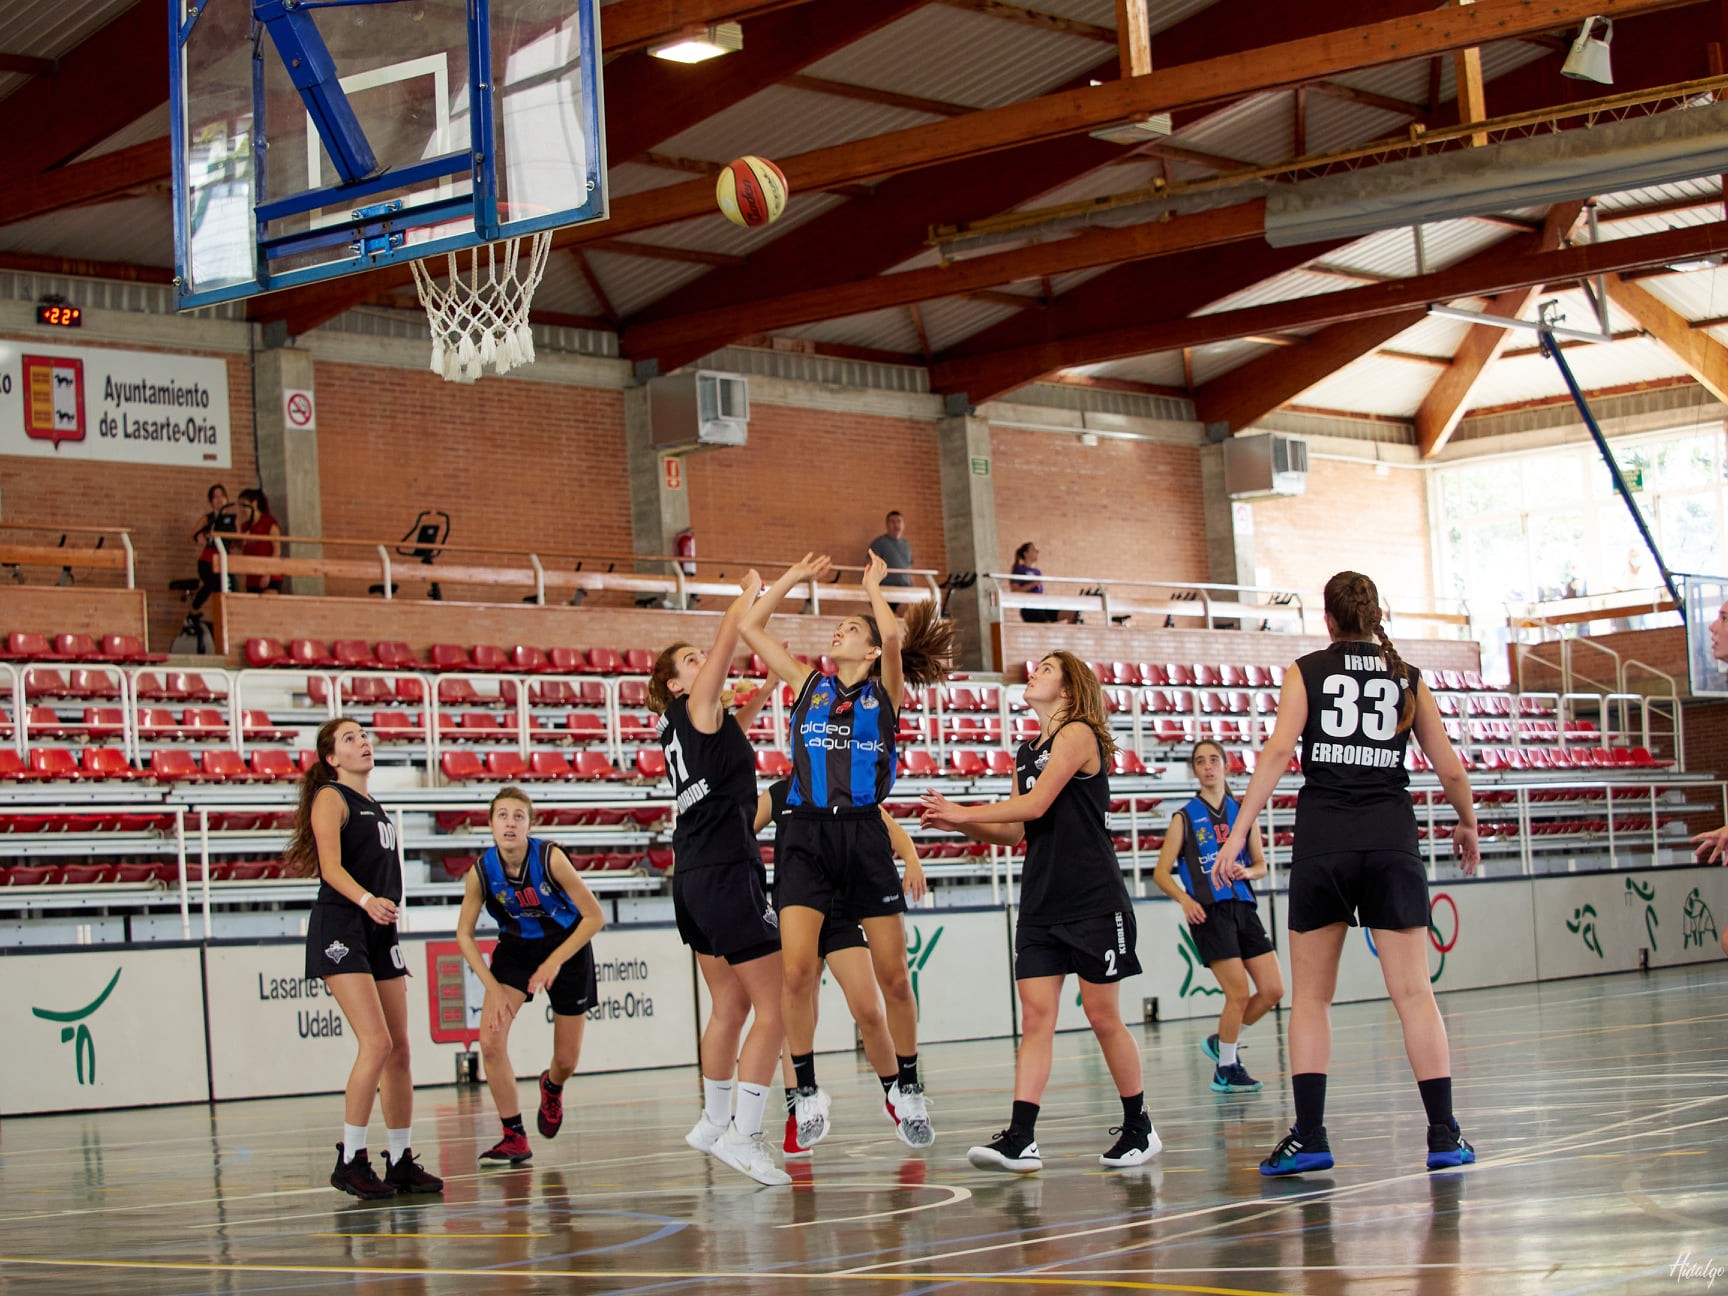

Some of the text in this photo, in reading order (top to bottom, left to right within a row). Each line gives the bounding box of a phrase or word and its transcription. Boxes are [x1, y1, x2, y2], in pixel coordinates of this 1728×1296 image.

[104, 374, 209, 407] Ayuntamiento
[100, 411, 218, 445] de Lasarte-Oria
[1344, 654, 1388, 672] IRUN
[1320, 673, 1400, 741] 33
[804, 736, 885, 753] agunak
[1311, 742, 1401, 768] ERROIBIDE
[376, 820, 397, 851] 00
[514, 886, 541, 908] 10
[594, 956, 648, 983] amiento
[1104, 948, 1118, 977] 2
[298, 1008, 343, 1039] Udala
